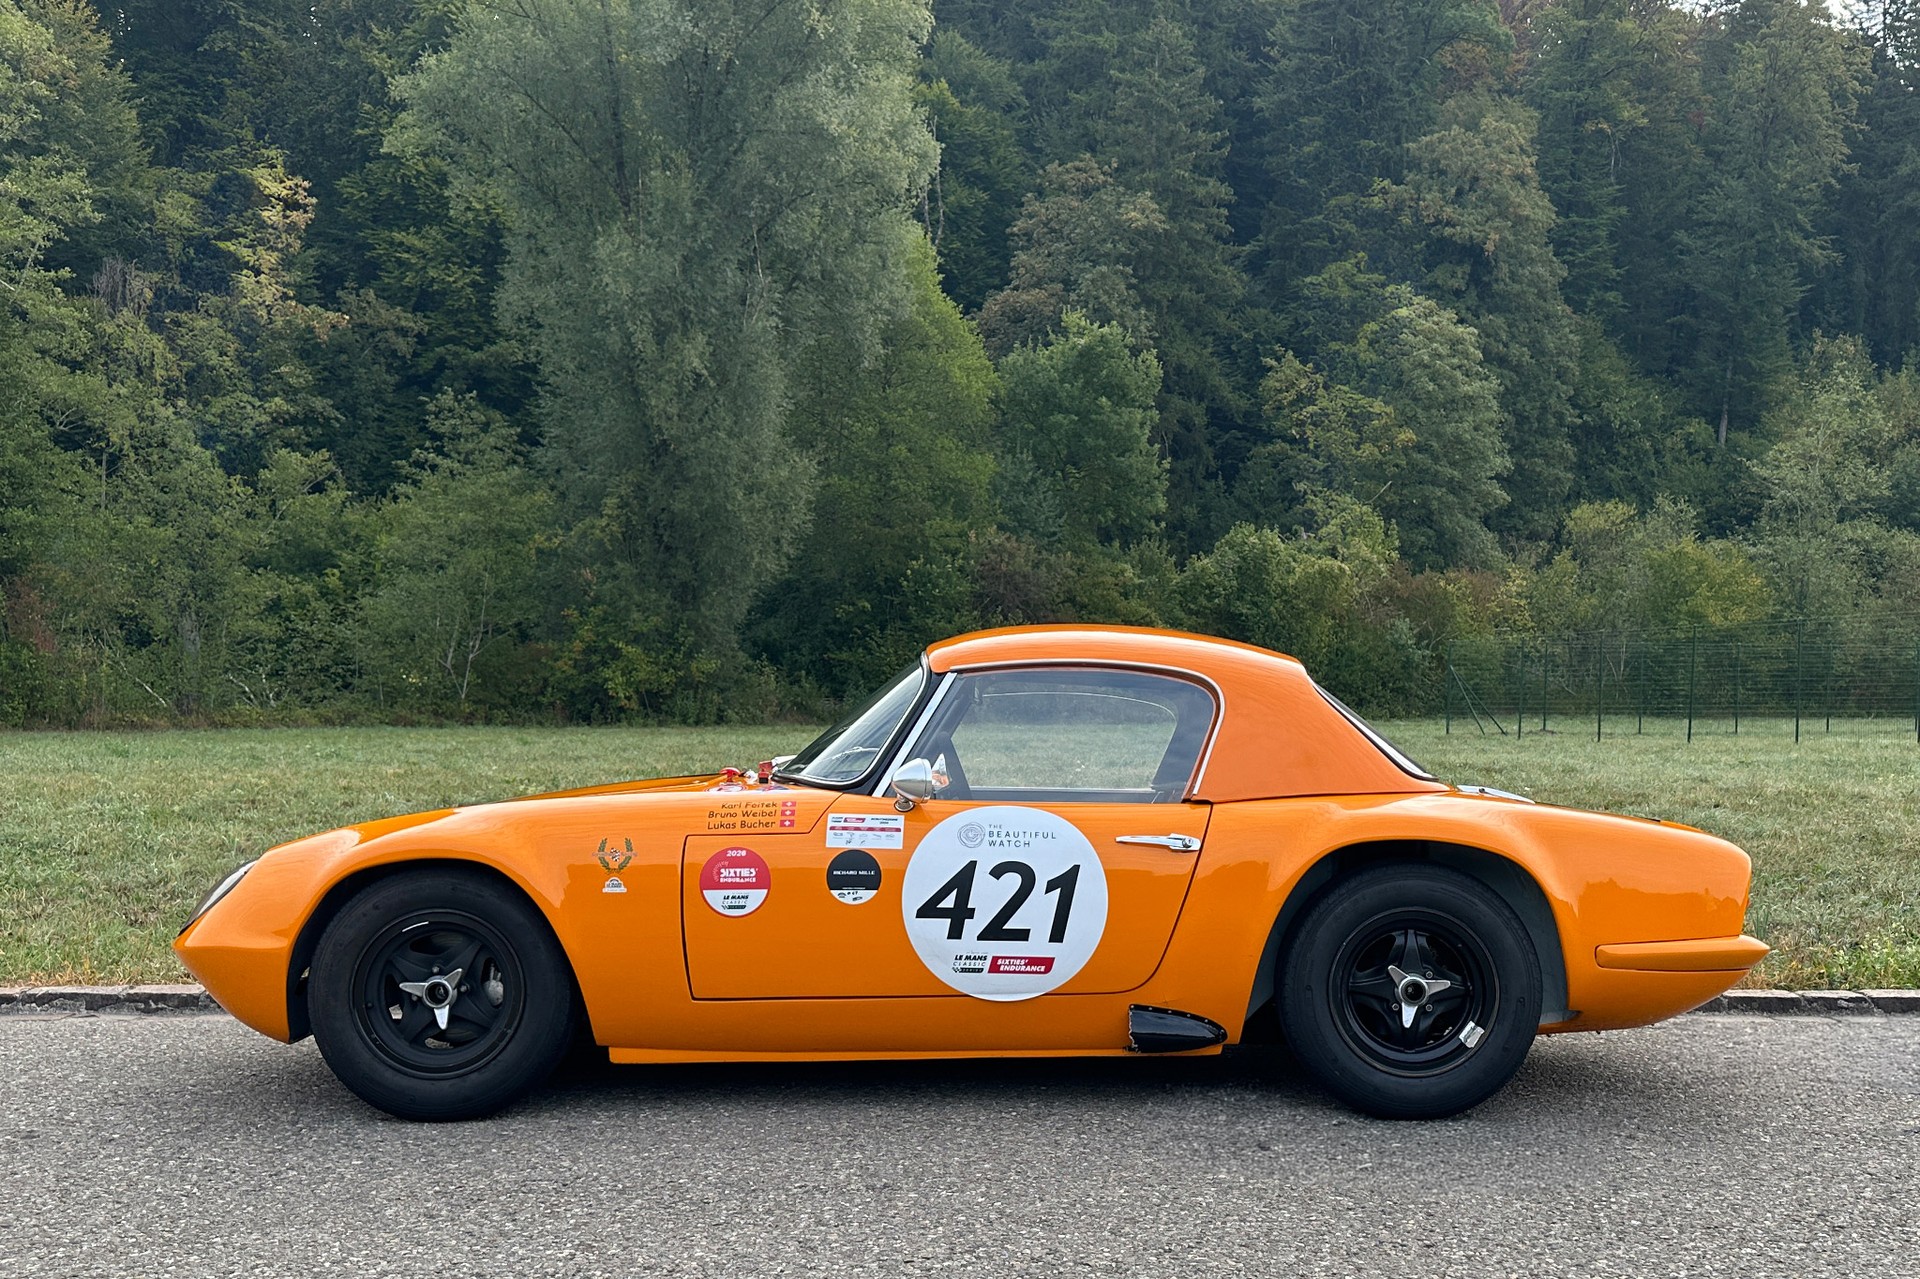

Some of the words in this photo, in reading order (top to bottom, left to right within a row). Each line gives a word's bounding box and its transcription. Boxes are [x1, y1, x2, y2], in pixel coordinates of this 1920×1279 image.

[708, 810, 738, 818] Bruno
[742, 810, 777, 818] Weibel
[708, 822, 736, 830] Lukas
[740, 820, 776, 828] Bucher
[988, 830, 1056, 840] BEAUTIFUL
[915, 860, 1080, 944] 421
